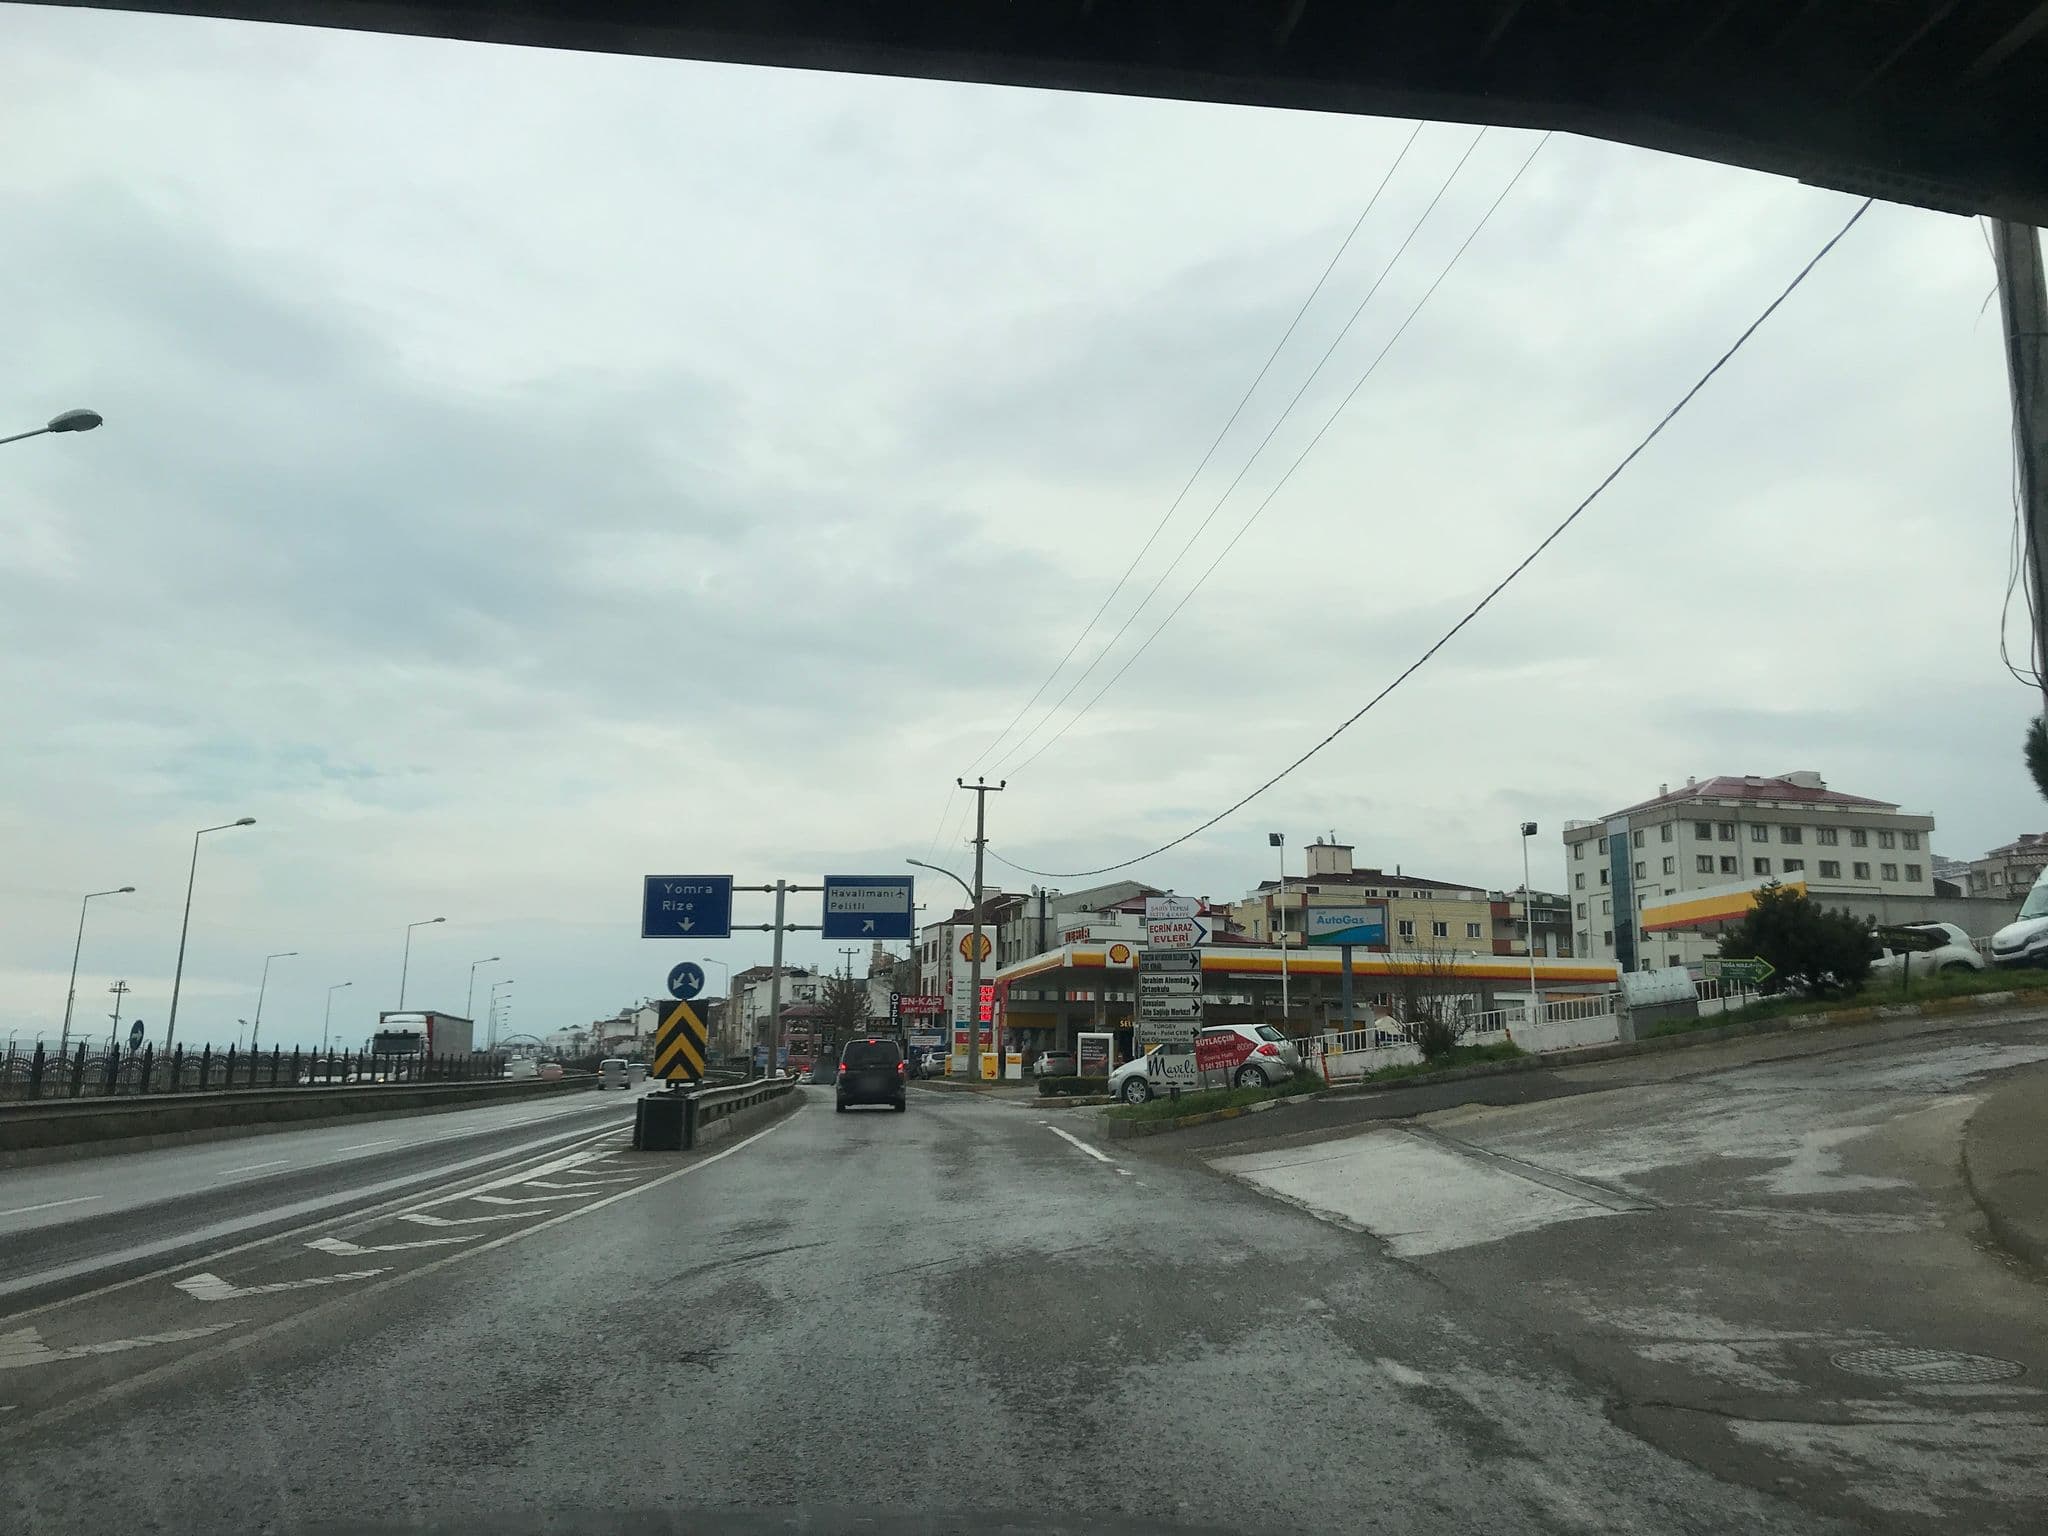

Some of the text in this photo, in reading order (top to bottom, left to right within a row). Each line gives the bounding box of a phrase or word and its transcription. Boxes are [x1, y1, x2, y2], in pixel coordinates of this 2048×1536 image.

[664, 883, 713, 894] Yomra
[662, 900, 694, 911] Rize
[830, 902, 865, 910] Pelitli
[1316, 915, 1365, 925] AutoGas
[1149, 923, 1193, 933] ECRİN ARAZ
[1153, 932, 1189, 943] EVLERİ
[901, 997, 942, 1006] EN-KAR
[891, 993, 899, 1025] OTEL
[1148, 1056, 1196, 1078] Mavili
